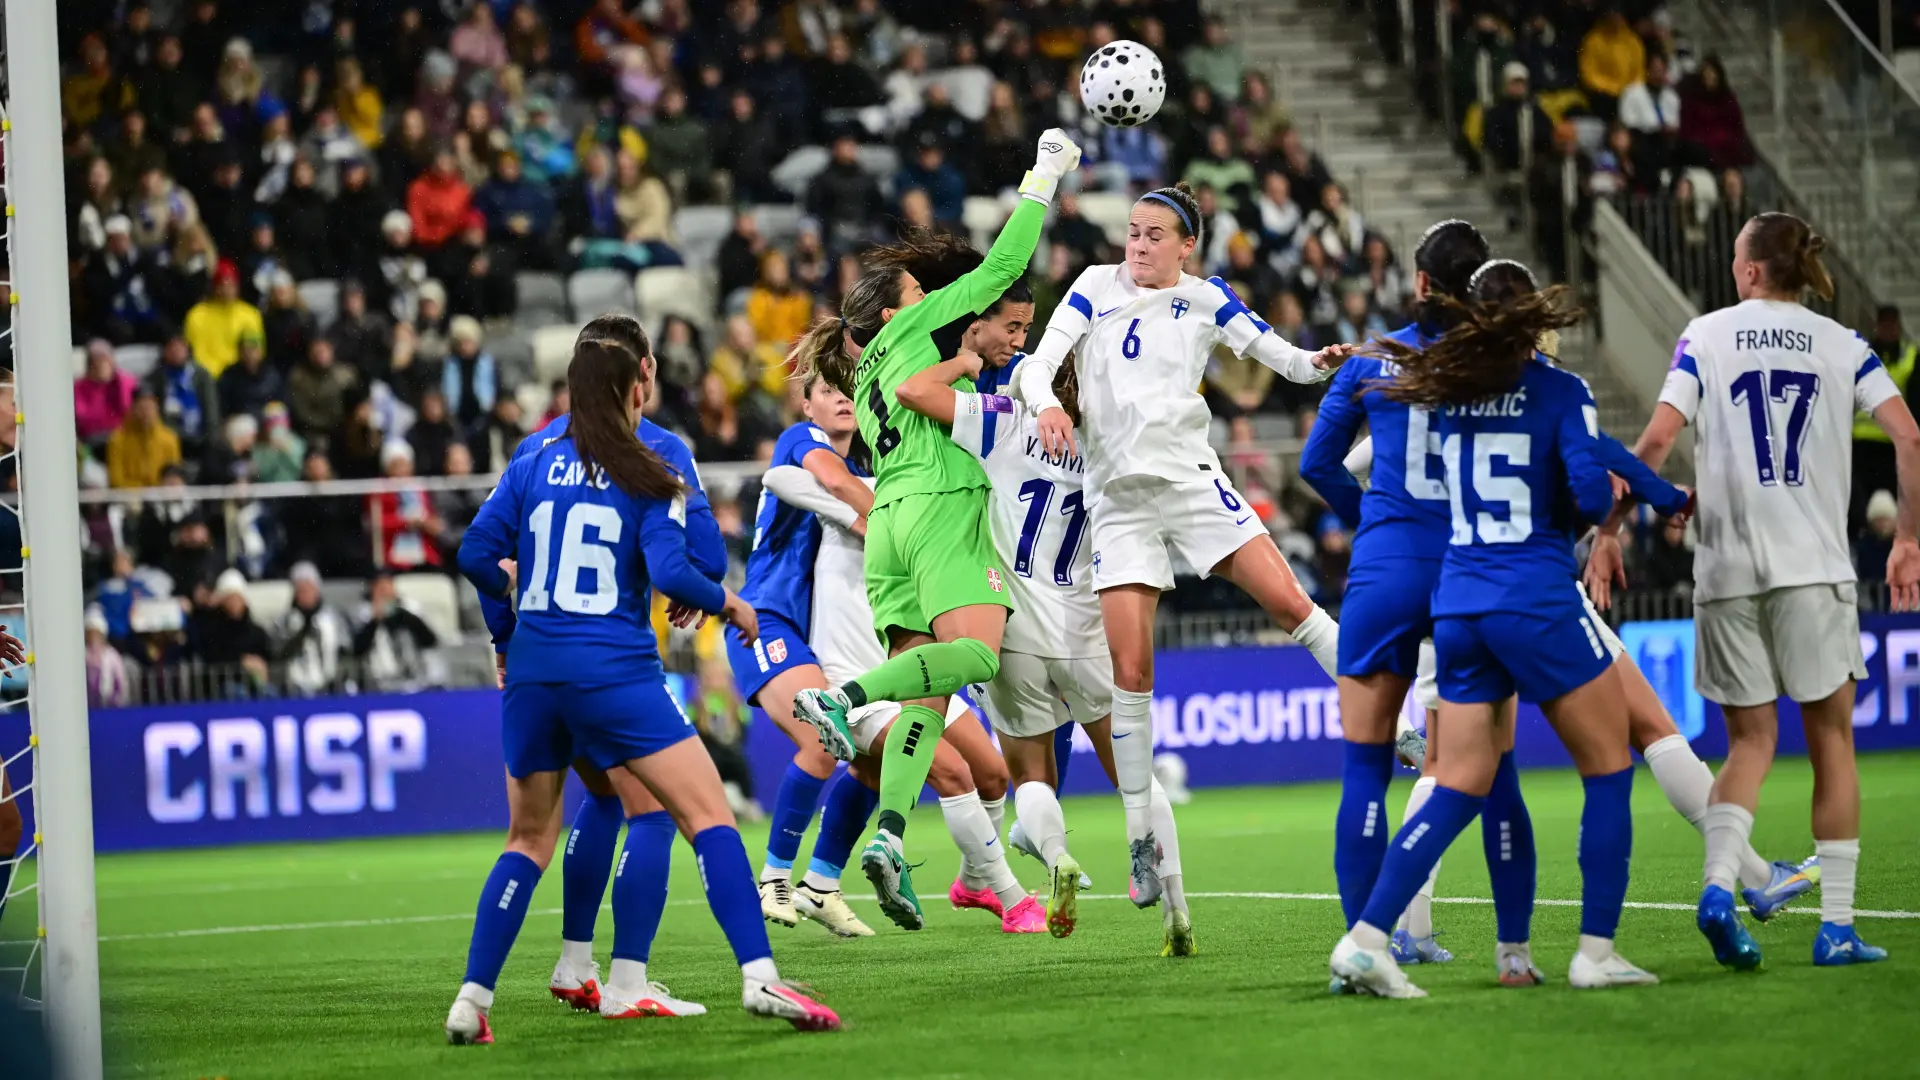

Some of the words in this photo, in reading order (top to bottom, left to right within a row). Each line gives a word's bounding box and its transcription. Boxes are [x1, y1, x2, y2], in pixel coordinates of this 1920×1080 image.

[1122, 318, 1142, 361] 6
[1736, 329, 1812, 353] FRANSSI
[868, 377, 901, 459] 1
[1730, 369, 1820, 487] 17
[1014, 478, 1089, 586] 11
[1214, 478, 1243, 512] 6
[1442, 433, 1533, 546] 15
[519, 500, 622, 615] 16
[144, 709, 427, 823] CRISP
